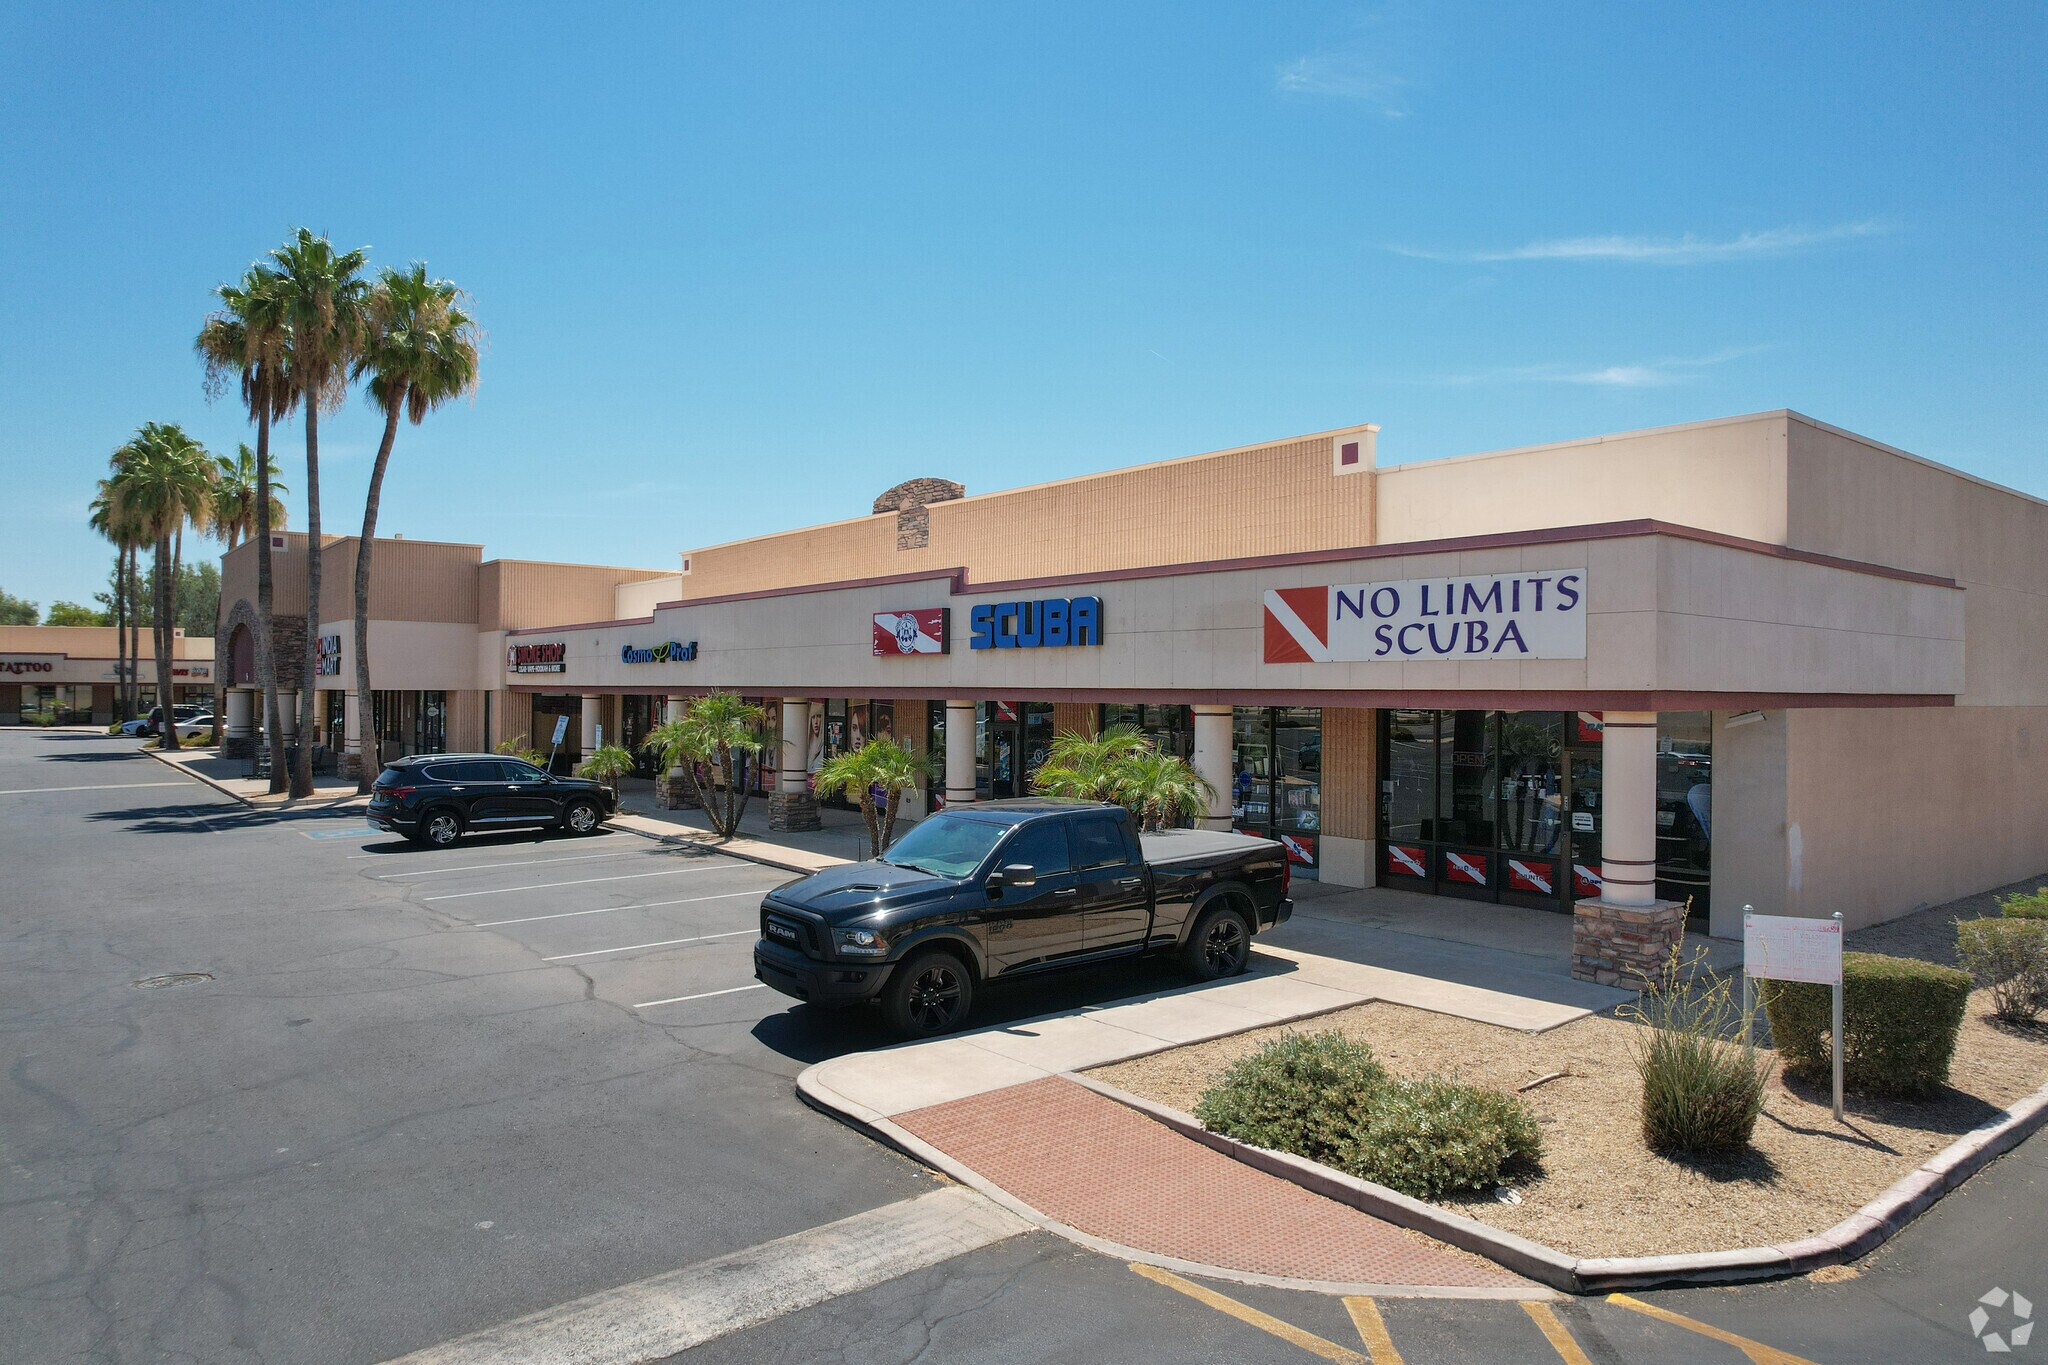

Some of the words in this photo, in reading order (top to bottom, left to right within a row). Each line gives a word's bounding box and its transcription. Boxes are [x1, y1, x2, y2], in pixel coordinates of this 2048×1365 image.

[1336, 587, 1400, 621] NO
[1420, 575, 1580, 617] LIMITS
[970, 596, 1103, 650] SCUBA
[321, 635, 340, 656] INDIA
[1374, 619, 1529, 656] SCUBA
[517, 645, 541, 664] SMOKE
[541, 643, 565, 662] SHOP
[621, 645, 653, 664] Cosmo
[669, 641, 697, 662] Prof
[321, 657, 340, 676] MART
[769, 925, 796, 938] RAM
